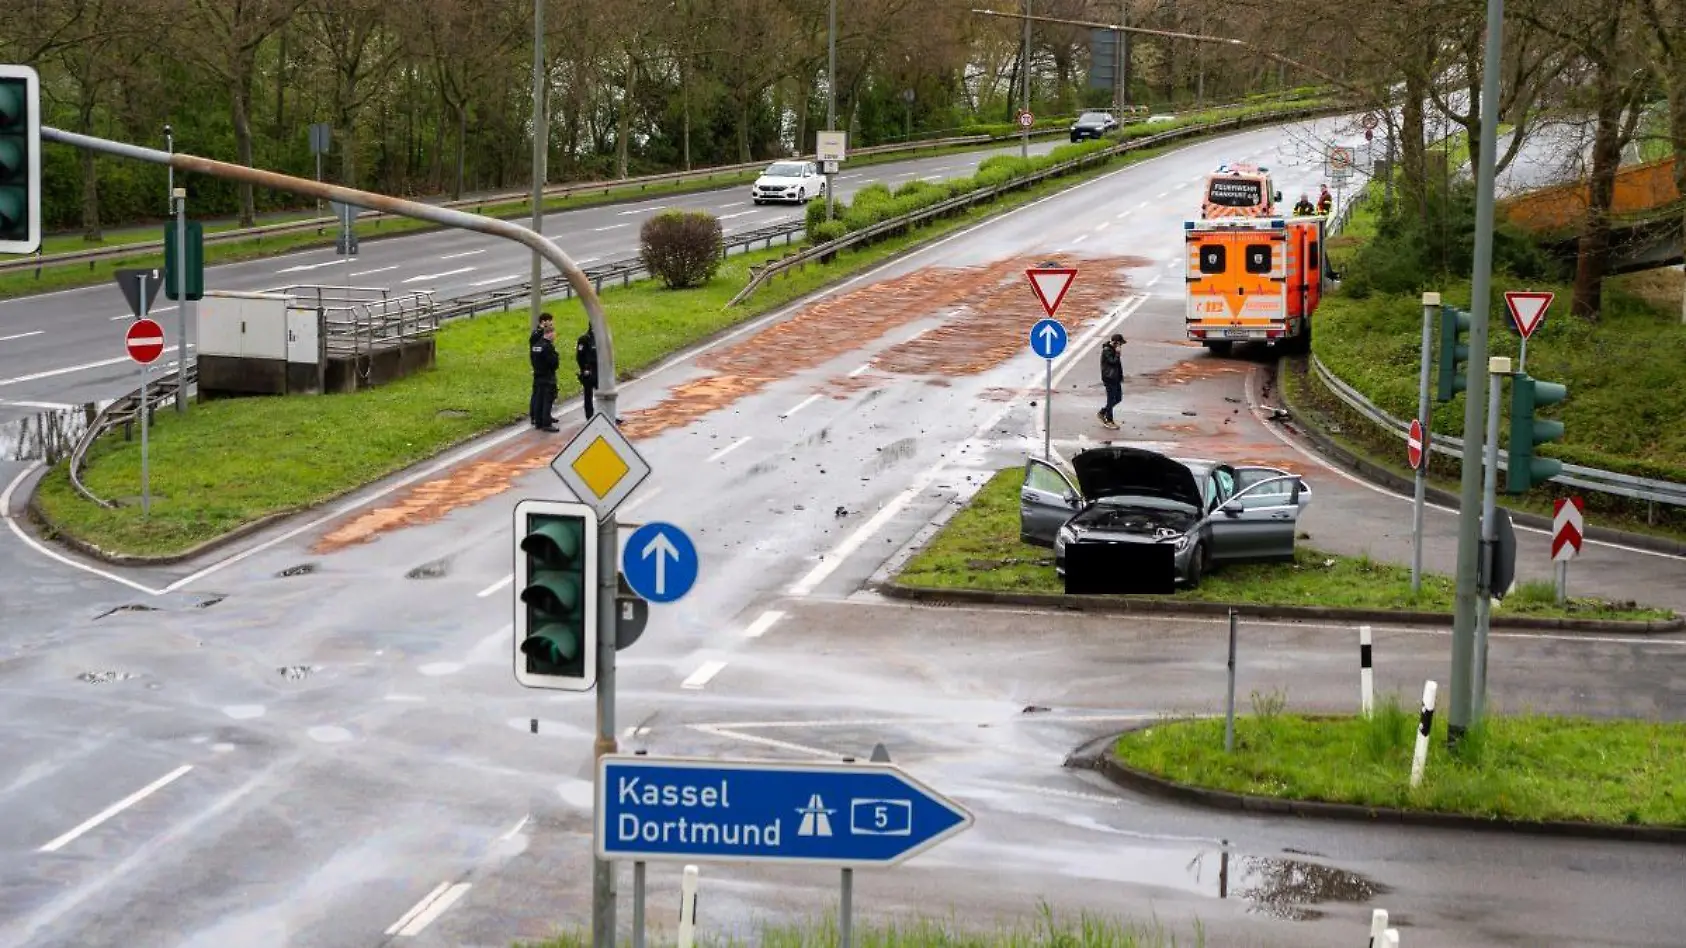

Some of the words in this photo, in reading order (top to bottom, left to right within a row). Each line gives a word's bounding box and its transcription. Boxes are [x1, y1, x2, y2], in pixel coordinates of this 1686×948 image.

[1214, 183, 1257, 192] FEUERWEHR
[618, 776, 730, 808] Kassel
[618, 813, 781, 846] Dortmund
[875, 806, 888, 828] 5
